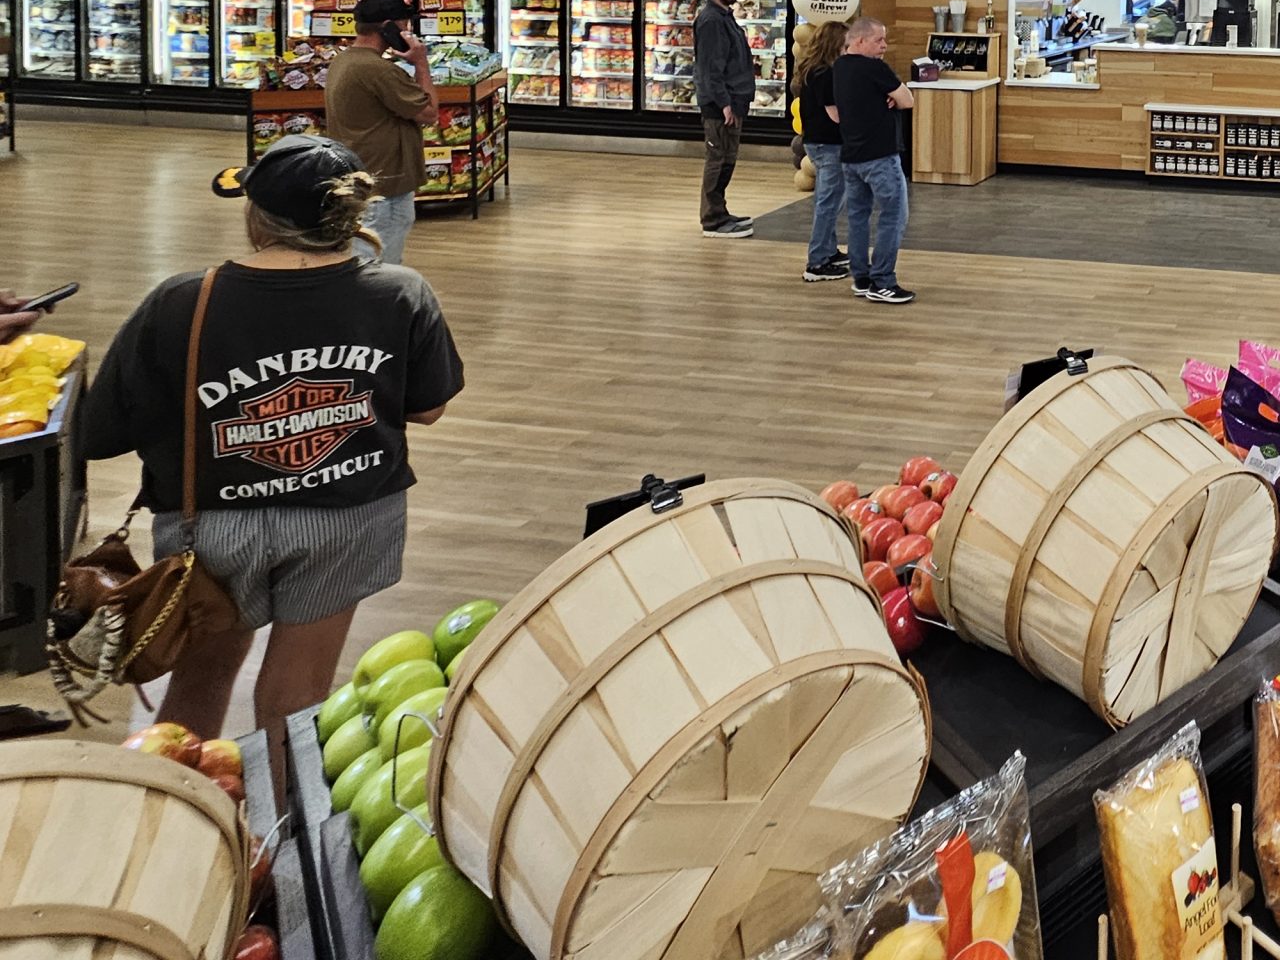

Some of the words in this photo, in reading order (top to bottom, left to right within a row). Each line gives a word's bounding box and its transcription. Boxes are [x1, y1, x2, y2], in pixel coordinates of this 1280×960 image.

[818, 2, 847, 11] Brews
[197, 345, 394, 410] DANBURY
[258, 387, 336, 417] MOTOR
[226, 400, 369, 446] HARLEY-DAVIDSON
[261, 429, 336, 467] CYCLES
[219, 450, 385, 500] CONNECTICUT
[1184, 902, 1206, 933] Angel
[1207, 894, 1220, 913] Fo
